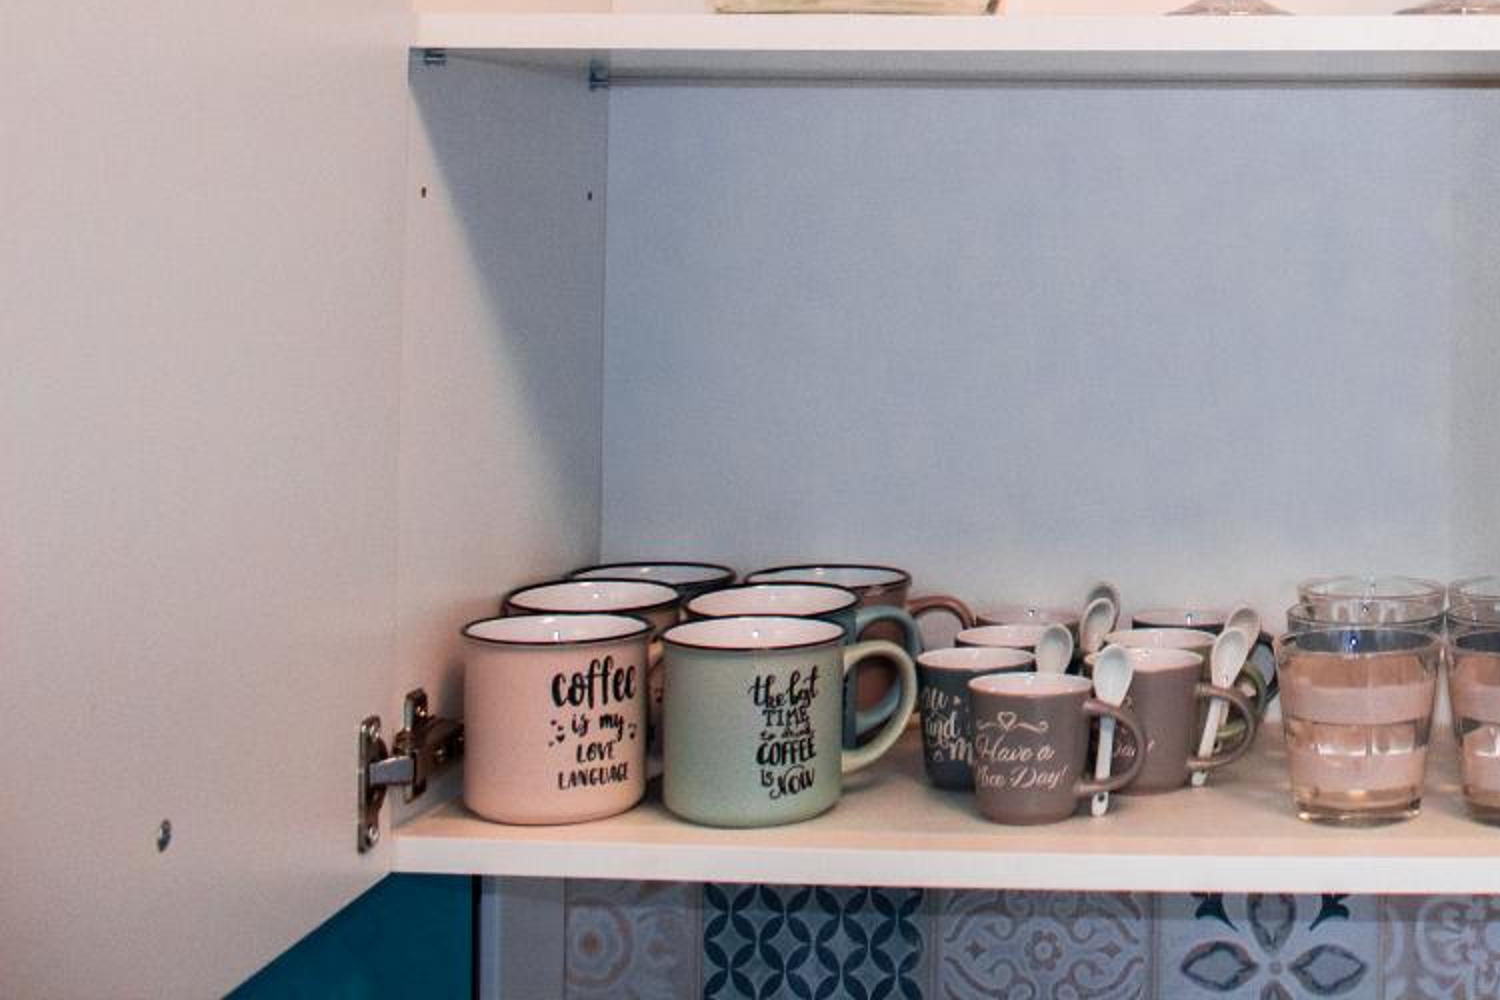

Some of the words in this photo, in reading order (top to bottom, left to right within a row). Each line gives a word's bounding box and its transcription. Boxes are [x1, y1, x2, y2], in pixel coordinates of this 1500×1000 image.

[552, 655, 638, 710] coffee
[747, 674, 786, 709] the
[571, 713, 590, 737] is
[599, 713, 624, 742] my
[762, 706, 810, 729] TIME
[576, 740, 617, 763] LOVE
[756, 738, 817, 766] COFFEE
[976, 731, 1034, 761] Have
[1037, 744, 1056, 761] a
[557, 762, 628, 791] LANGUAGE
